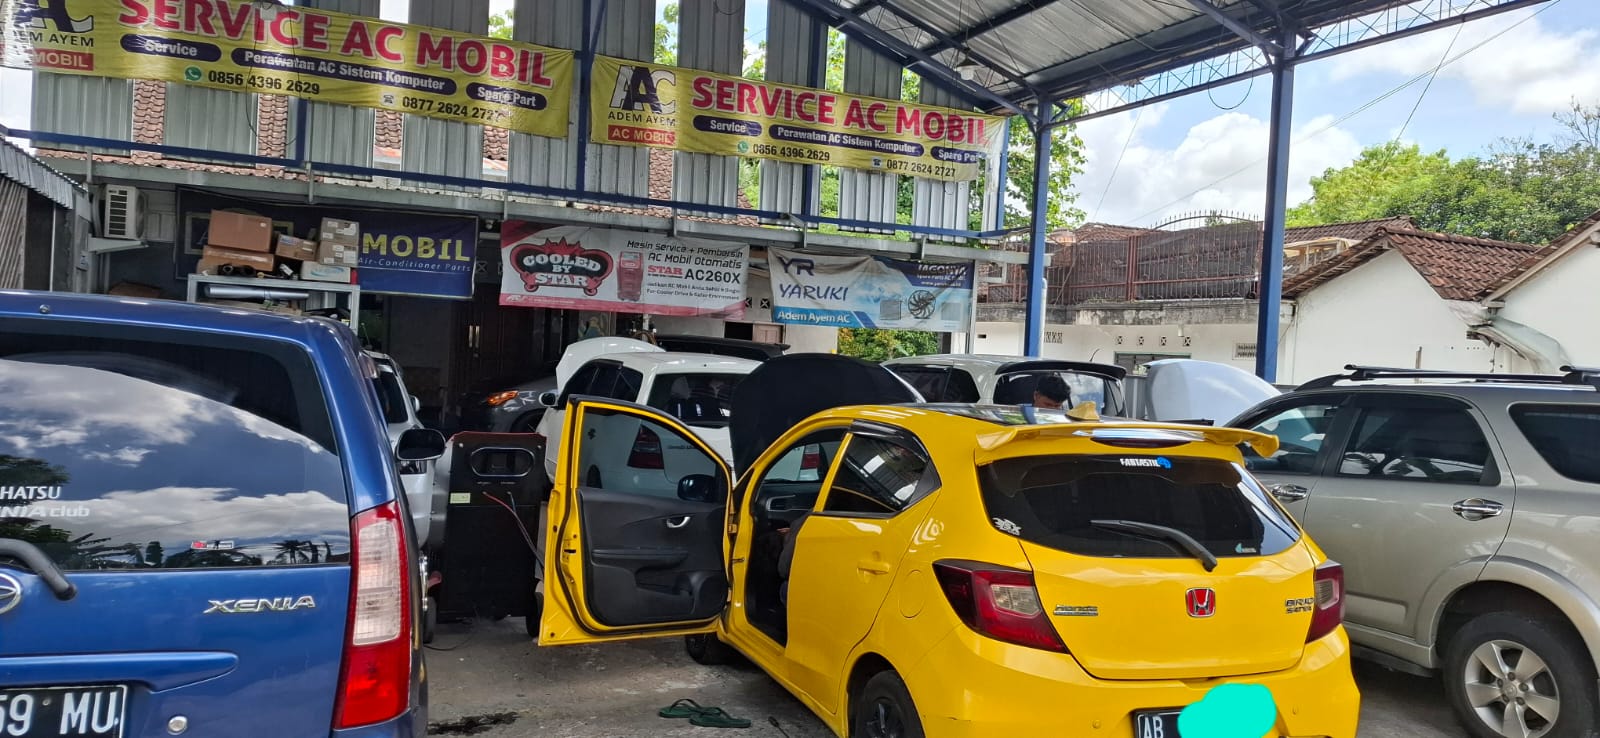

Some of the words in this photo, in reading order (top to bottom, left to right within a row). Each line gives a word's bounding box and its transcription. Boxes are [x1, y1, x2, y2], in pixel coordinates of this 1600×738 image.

[49, 33, 94, 47] AYEM
[118, 0, 331, 51] SERVICE
[339, 20, 404, 62] AC
[416, 32, 553, 88] MOBIL
[144, 39, 198, 57] Service
[244, 51, 315, 71] Perawatan
[318, 60, 336, 74] AC
[339, 64, 382, 81] Sistem
[385, 70, 446, 91] Komputer
[208, 70, 244, 86] 0856
[247, 74, 282, 90] 4396
[286, 79, 320, 95] 2629
[402, 96, 433, 112] 0877
[437, 102, 468, 117] 2624
[513, 92, 537, 107] Part
[608, 111, 642, 123] ADEM
[646, 115, 676, 126] AYEM
[691, 76, 836, 125] SERVICE
[843, 98, 888, 133] AC
[895, 105, 986, 146] MOBIL
[710, 119, 747, 133] Service
[612, 129, 630, 139] AC
[634, 131, 675, 146] MOBIL
[777, 127, 826, 142] Perawatan
[829, 133, 840, 144] AC
[842, 135, 872, 147] Sistem
[875, 140, 916, 153] Komputer
[753, 144, 777, 156] 0856
[780, 146, 804, 158] 4396
[807, 149, 830, 161] 2629
[938, 149, 962, 161] Spare
[887, 159, 908, 171] 0877
[911, 163, 932, 174] 2624
[934, 166, 956, 178] 2727
[362, 233, 470, 261] MOBIL
[627, 240, 653, 250] Mesin
[655, 243, 687, 253] Service
[358, 258, 441, 270] Air-Conditioner
[445, 263, 471, 272] Parts
[523, 253, 601, 272] COOLED
[552, 264, 572, 273] BY
[648, 253, 662, 262] AC
[664, 253, 692, 265] Mobil
[695, 256, 742, 269] Otomatis
[776, 256, 814, 276] YR
[535, 272, 588, 287] STAR
[648, 265, 683, 275] STAR
[684, 269, 741, 284] AC260X
[779, 283, 849, 301] YARUKI
[777, 311, 807, 321] Adem
[809, 312, 836, 324] Ayem
[837, 314, 850, 323] AC
[49, 505, 90, 517] club
[203, 595, 316, 614] XENIA
[59, 691, 117, 735] MU
[1143, 715, 1164, 738] AB
